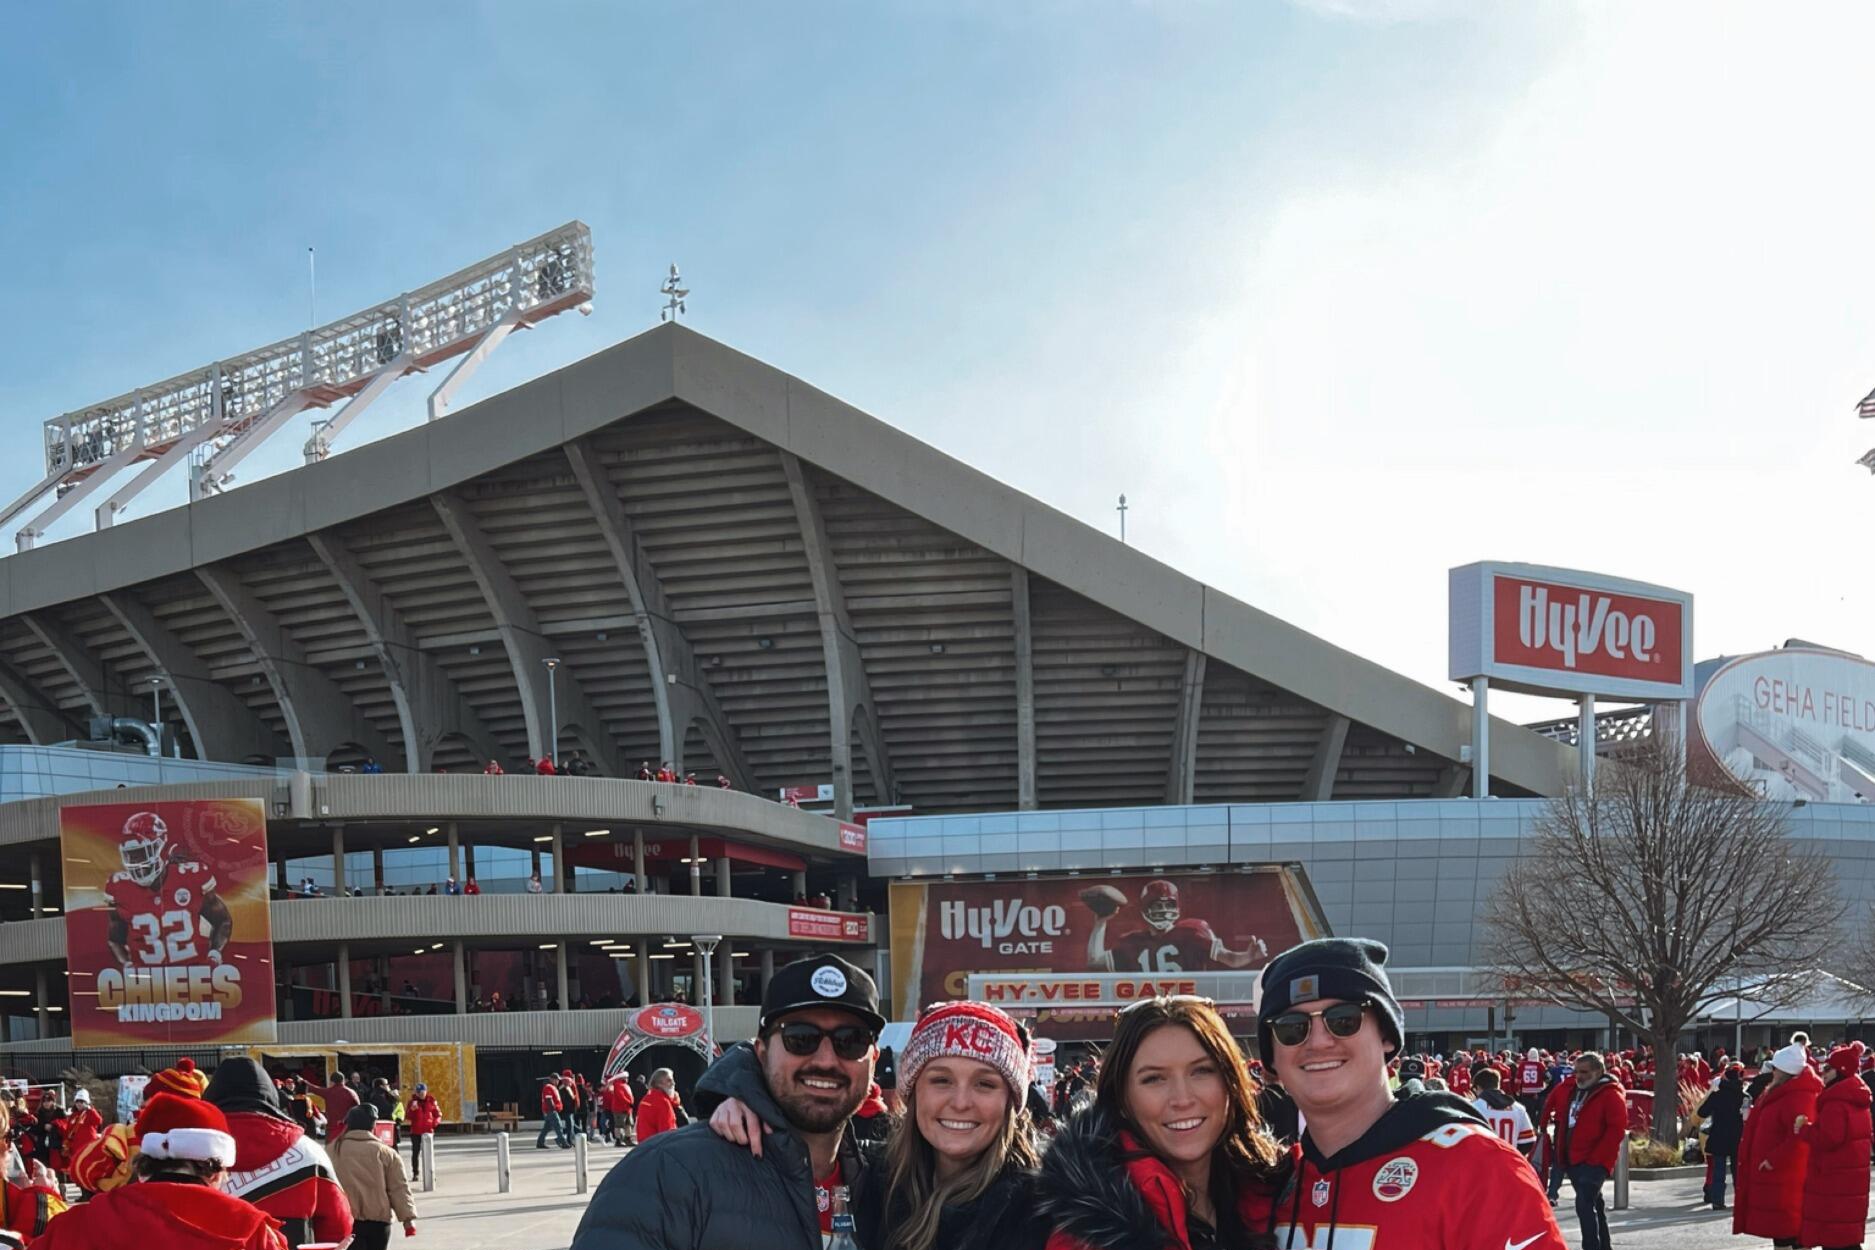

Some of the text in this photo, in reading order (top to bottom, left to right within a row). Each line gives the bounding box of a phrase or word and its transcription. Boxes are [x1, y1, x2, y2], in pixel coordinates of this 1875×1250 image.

[1520, 584, 1655, 668] HyVee
[1754, 675, 1875, 732] GEHA FIELD
[131, 909, 199, 964] 32
[940, 898, 1066, 948] HyVee
[998, 941, 1053, 955] GATE
[1137, 944, 1183, 972] 16
[97, 964, 243, 1012] CHIEFS
[1115, 980, 1196, 999] GATE
[118, 1002, 222, 1022] KINGDOM
[651, 1016, 687, 1027] TAILGATE
[944, 1023, 993, 1054] KC
